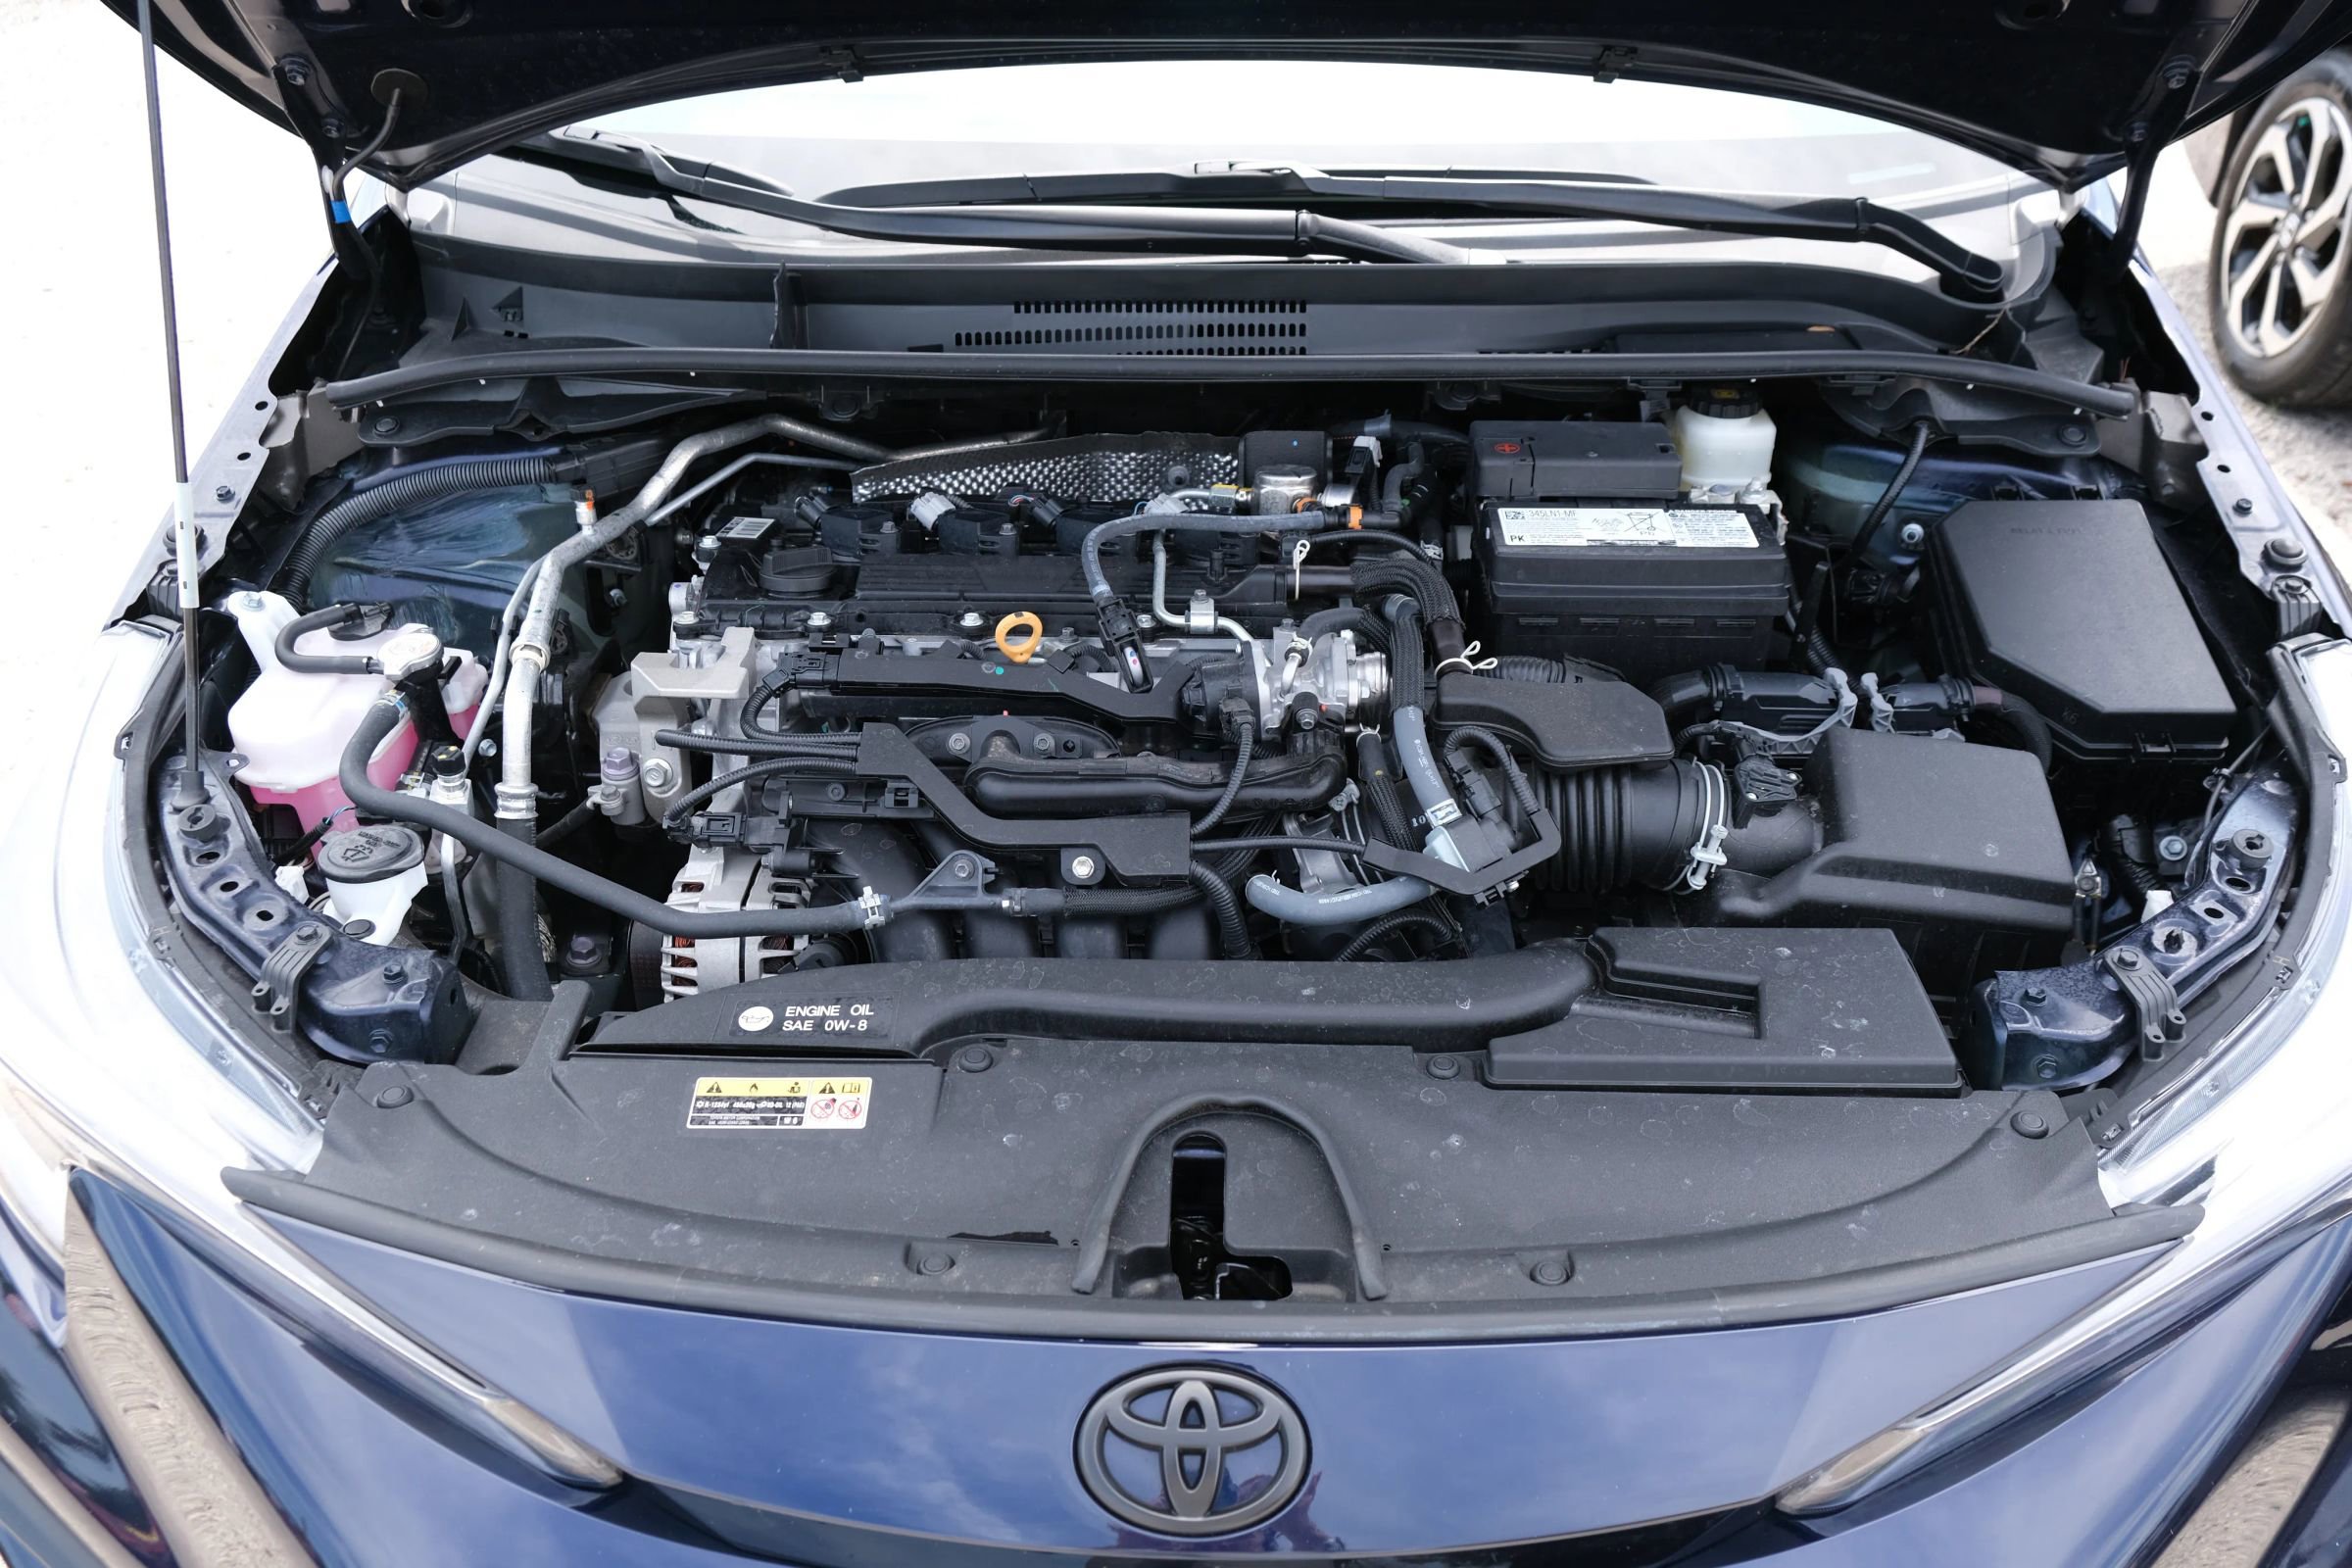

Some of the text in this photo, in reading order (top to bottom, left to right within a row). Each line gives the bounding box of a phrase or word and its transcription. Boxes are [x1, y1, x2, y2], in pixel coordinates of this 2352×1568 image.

[785, 1004, 874, 1017] ENGINE OIL
[782, 1019, 868, 1032] SAE 0W-8
